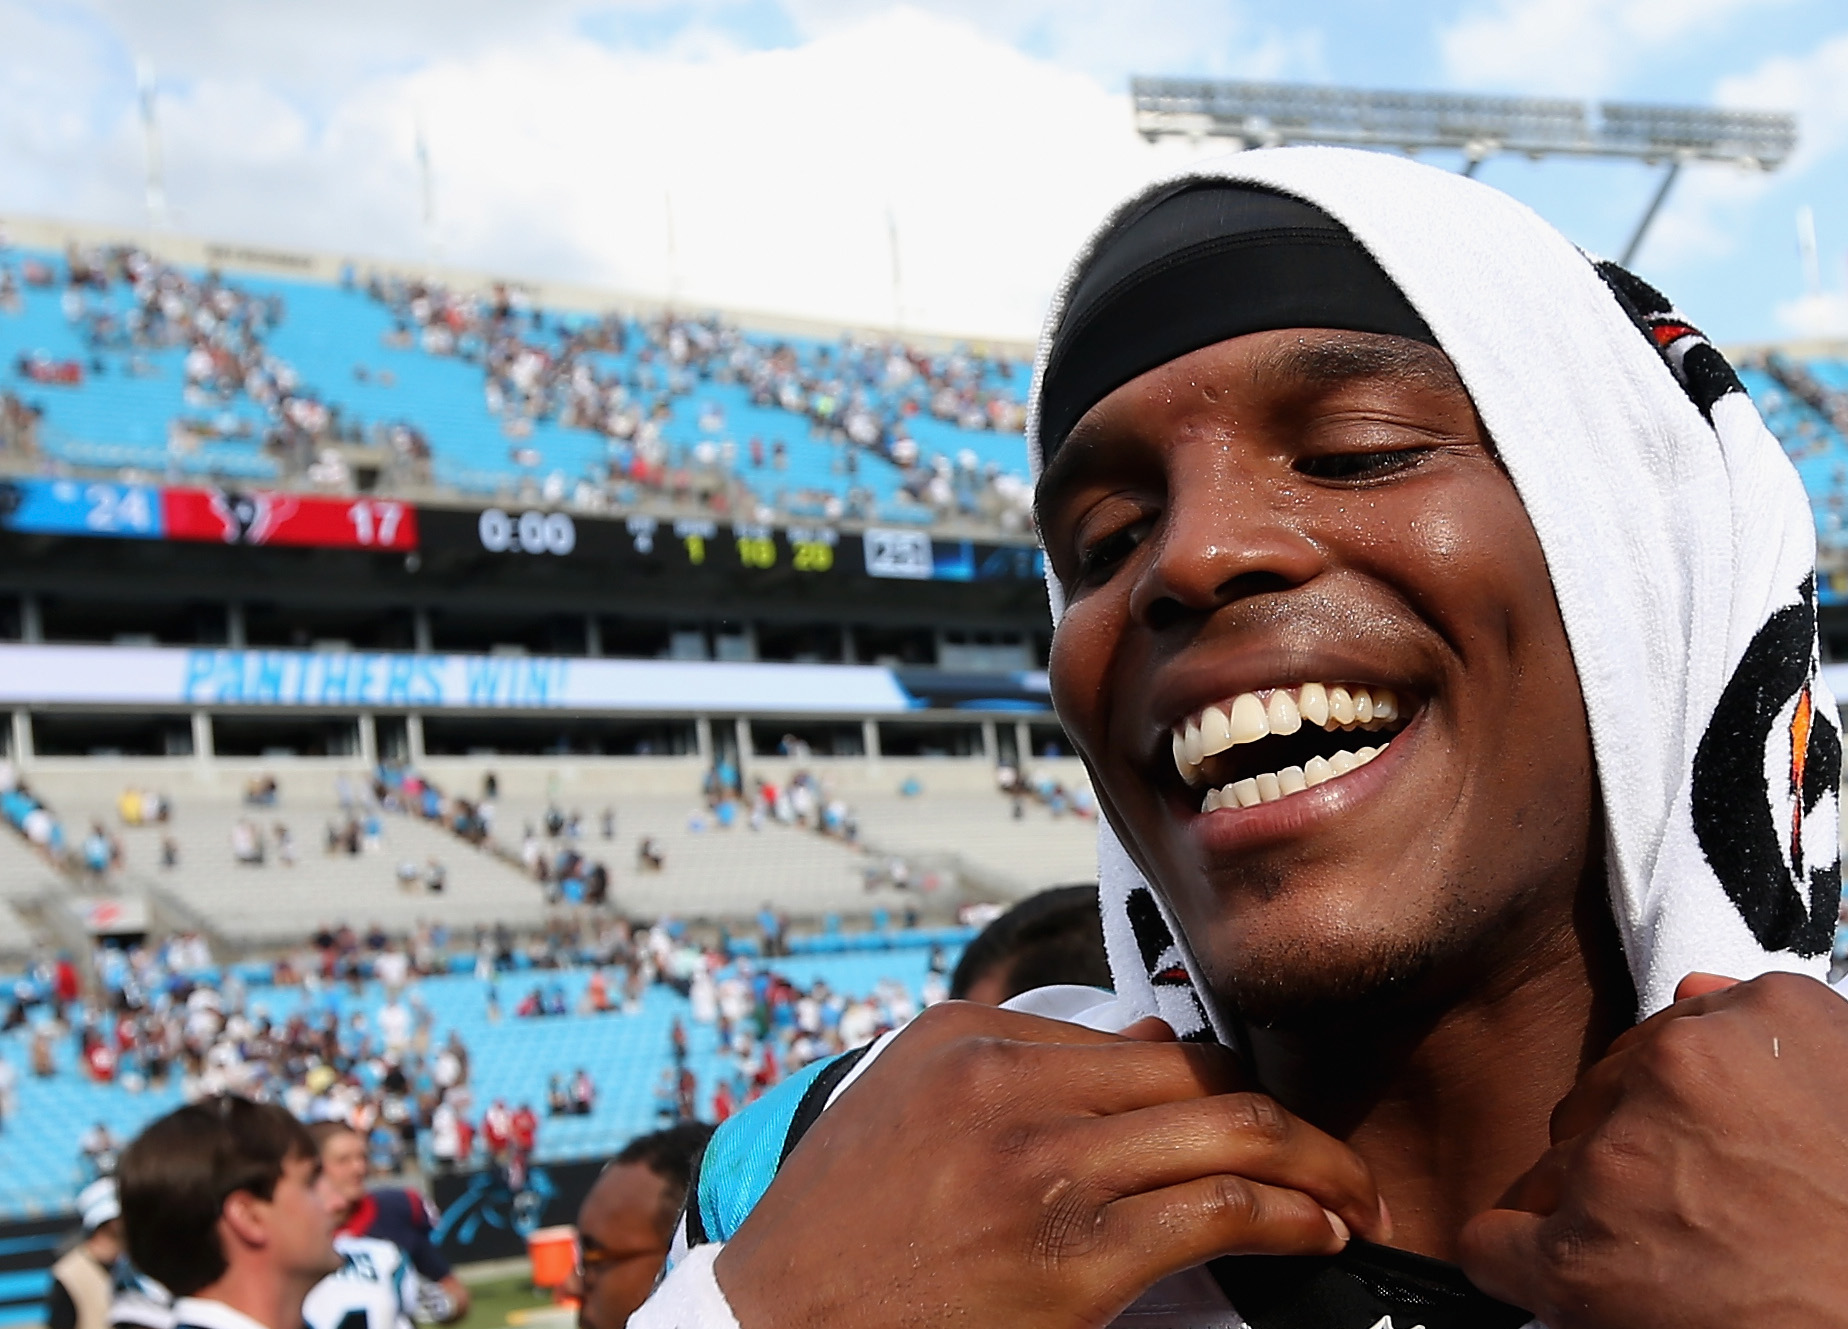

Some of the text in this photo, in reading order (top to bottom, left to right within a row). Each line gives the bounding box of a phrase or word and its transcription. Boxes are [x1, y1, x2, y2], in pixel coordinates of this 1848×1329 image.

[86, 484, 151, 533] 24
[349, 500, 405, 546] 17
[478, 507, 576, 556] 0:00
[182, 650, 446, 705] PANTHERS
